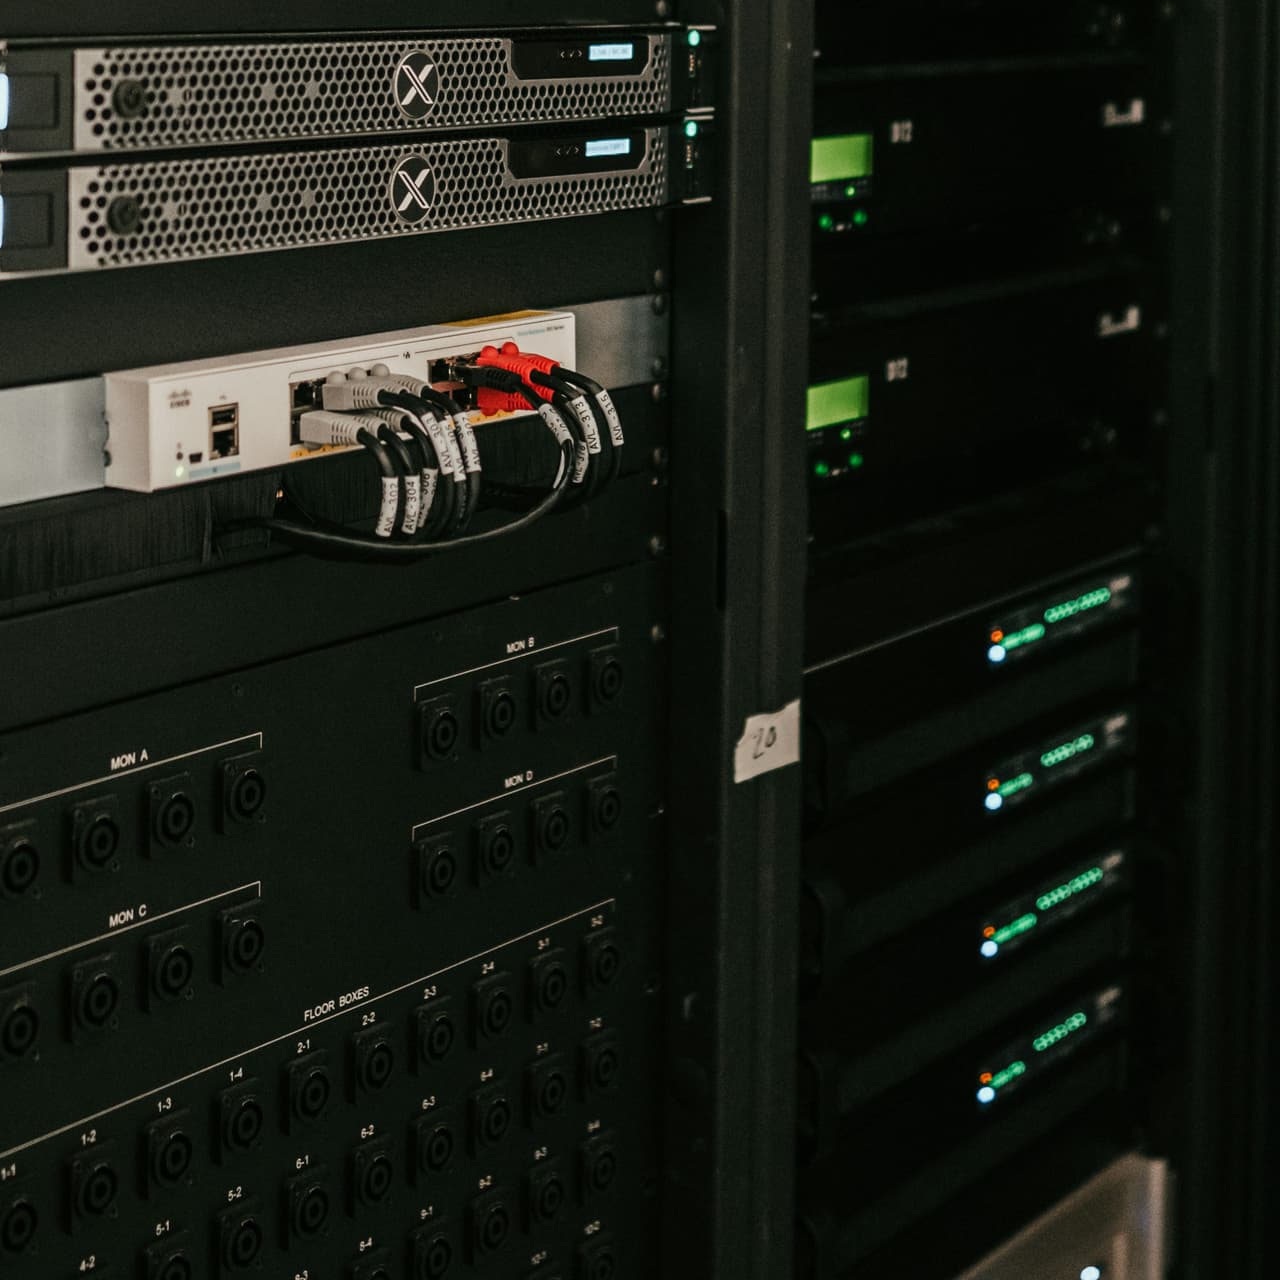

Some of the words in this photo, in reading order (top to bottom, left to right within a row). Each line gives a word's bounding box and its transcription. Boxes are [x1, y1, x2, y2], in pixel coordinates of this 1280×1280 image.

[506, 640, 525, 653] MON
[111, 752, 136, 771] MON
[139, 749, 149, 761] A
[505, 774, 523, 789] MON
[109, 910, 134, 928] MON
[138, 904, 147, 917] C
[423, 985, 437, 999] 2-3
[304, 1000, 336, 1022] FLOOR
[338, 986, 370, 1008] BOXES
[362, 1012, 376, 1026] 2-2
[297, 1039, 311, 1054] 2-1
[229, 1067, 243, 1082] 1-4
[157, 1097, 172, 1113] 1-3
[422, 1096, 436, 1110] 6-3
[81, 1129, 97, 1145] 1-2
[361, 1124, 374, 1140] 6-2
[296, 1155, 309, 1170] 6-1
[0, 1163, 16, 1181] 1-1
[227, 1186, 242, 1202] 5-2
[155, 1220, 170, 1236] 5-1
[79, 1255, 96, 1272] 4-2
